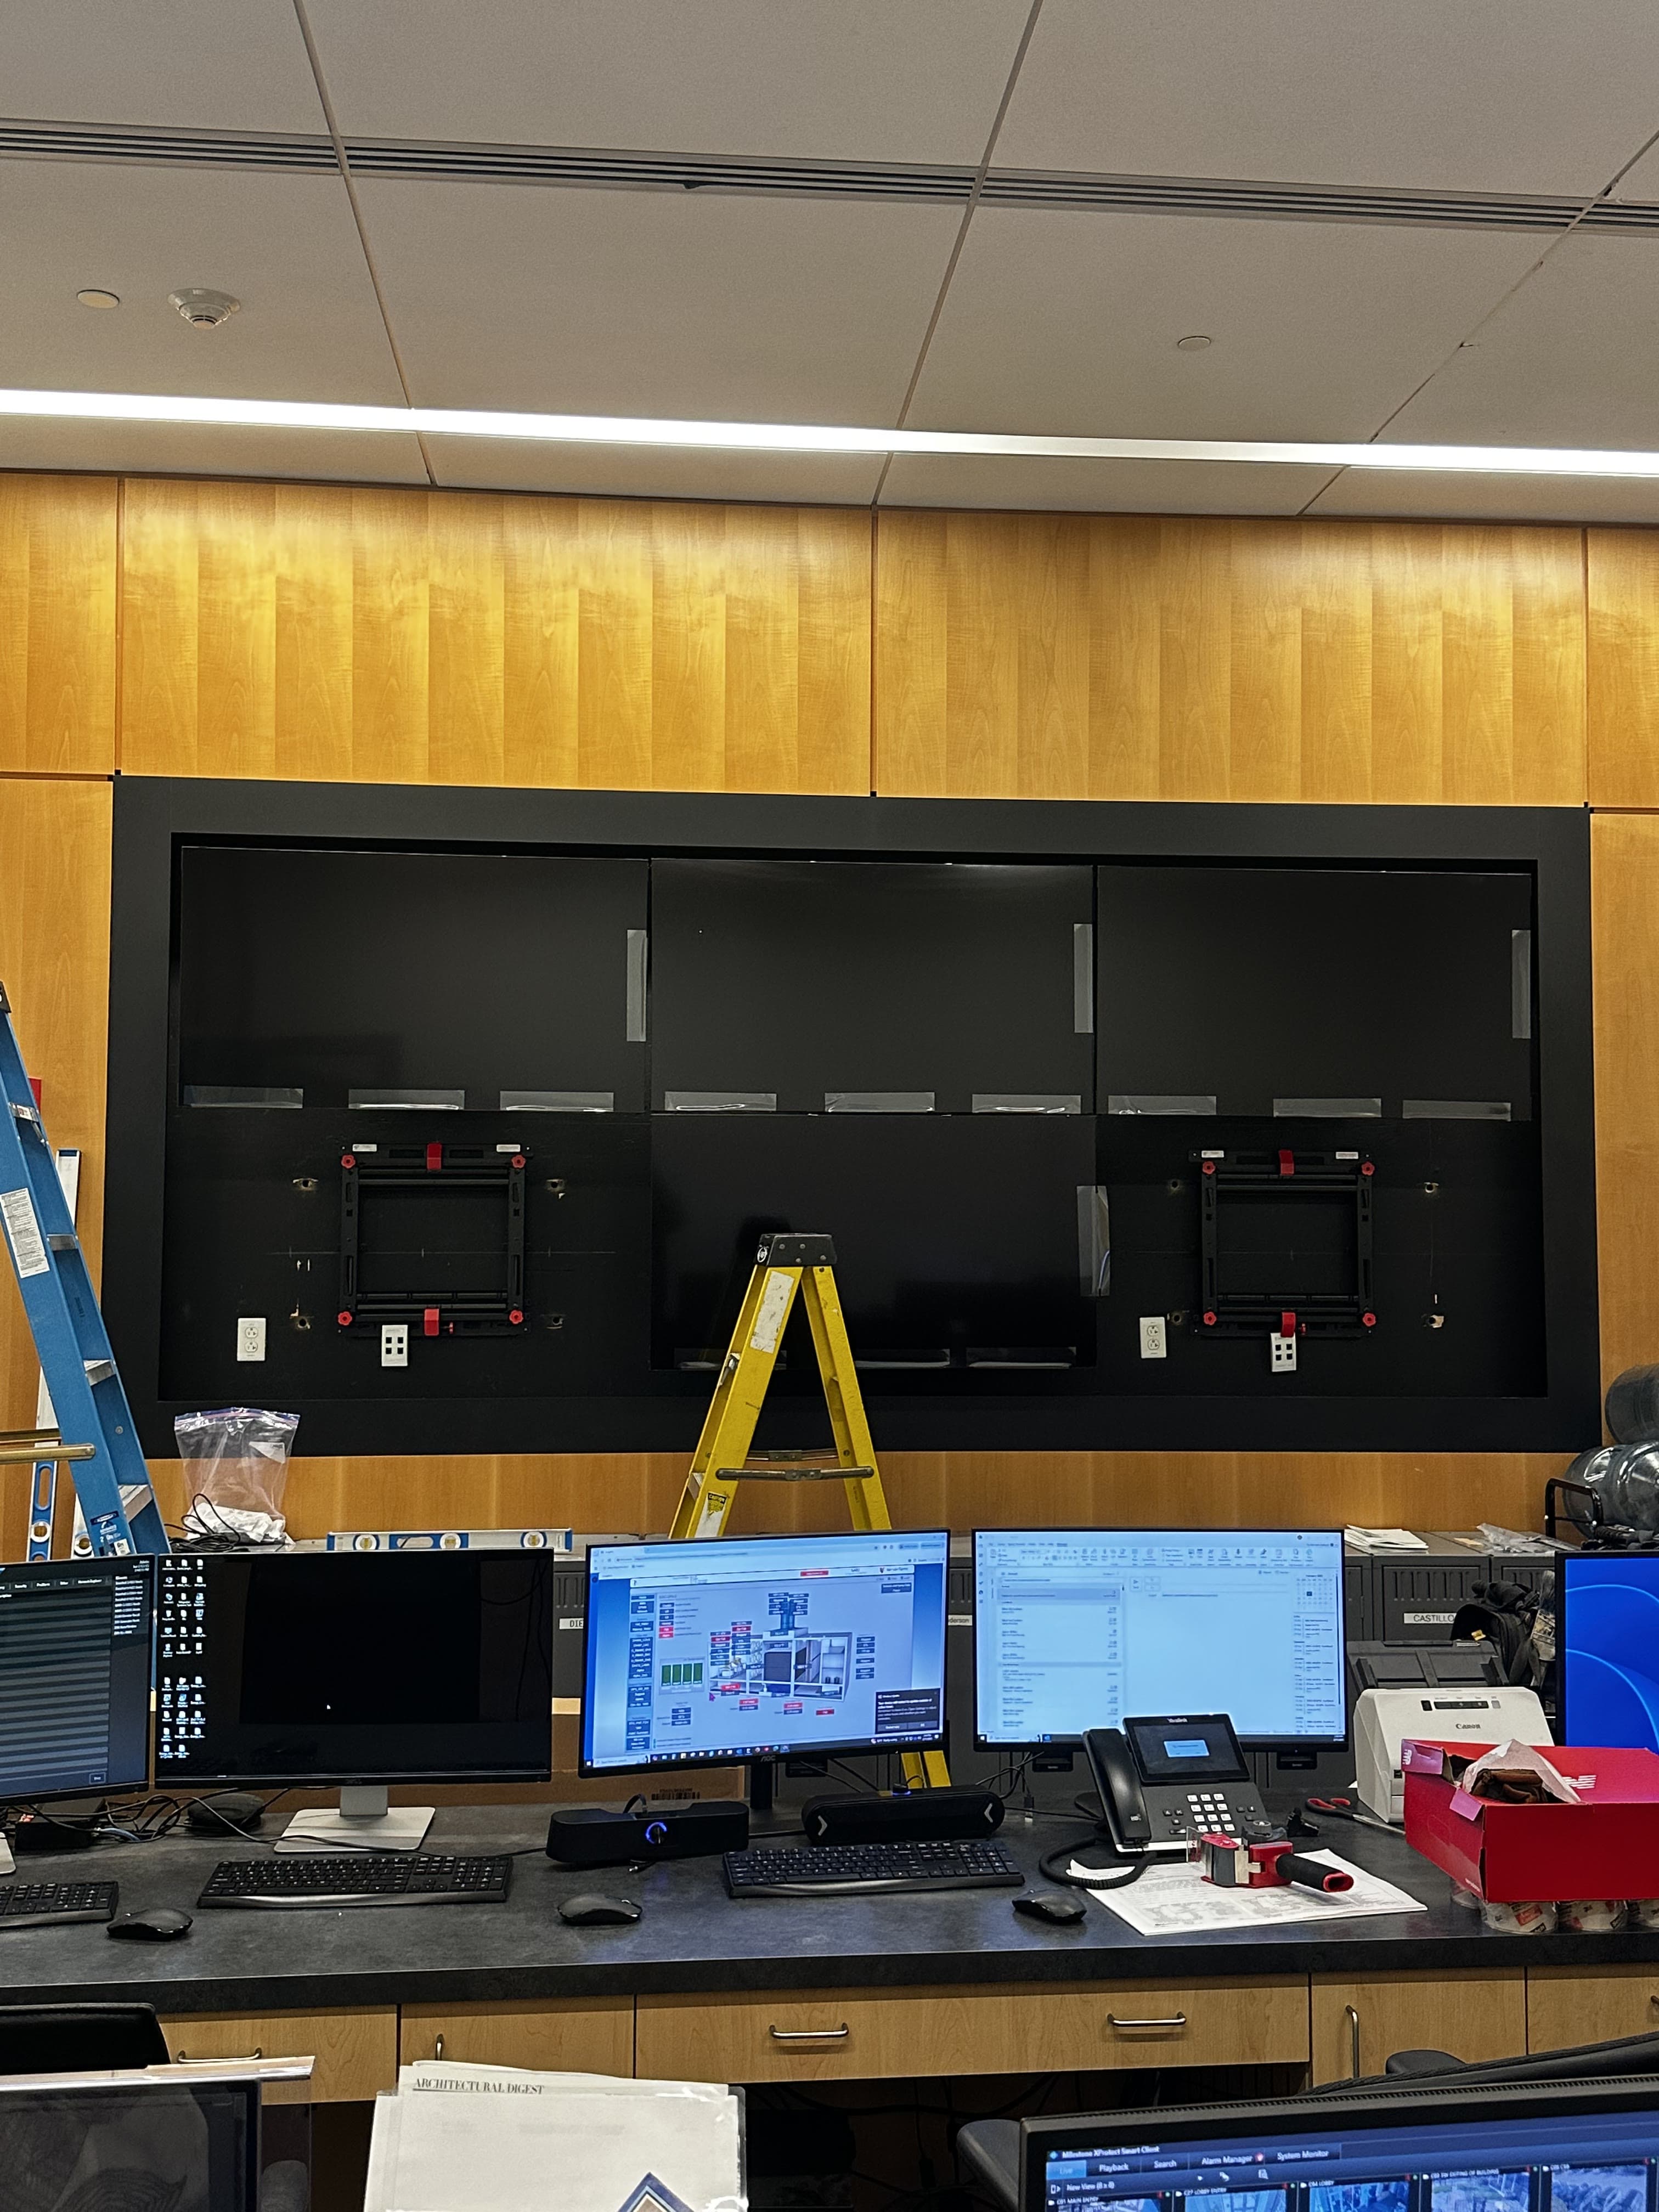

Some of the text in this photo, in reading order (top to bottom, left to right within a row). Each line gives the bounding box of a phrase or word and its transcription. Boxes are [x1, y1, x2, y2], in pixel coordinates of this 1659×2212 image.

[1413, 1614, 1455, 1622] CASTILLO
[416, 2078, 545, 2095] ARCHITECTURAL DIGEST
[1201, 2155, 1253, 2165] Alarm Manager
[1277, 2150, 1329, 2161] System Monitor
[1099, 2163, 1129, 2172] Playback
[1154, 2159, 1177, 2168] Search
